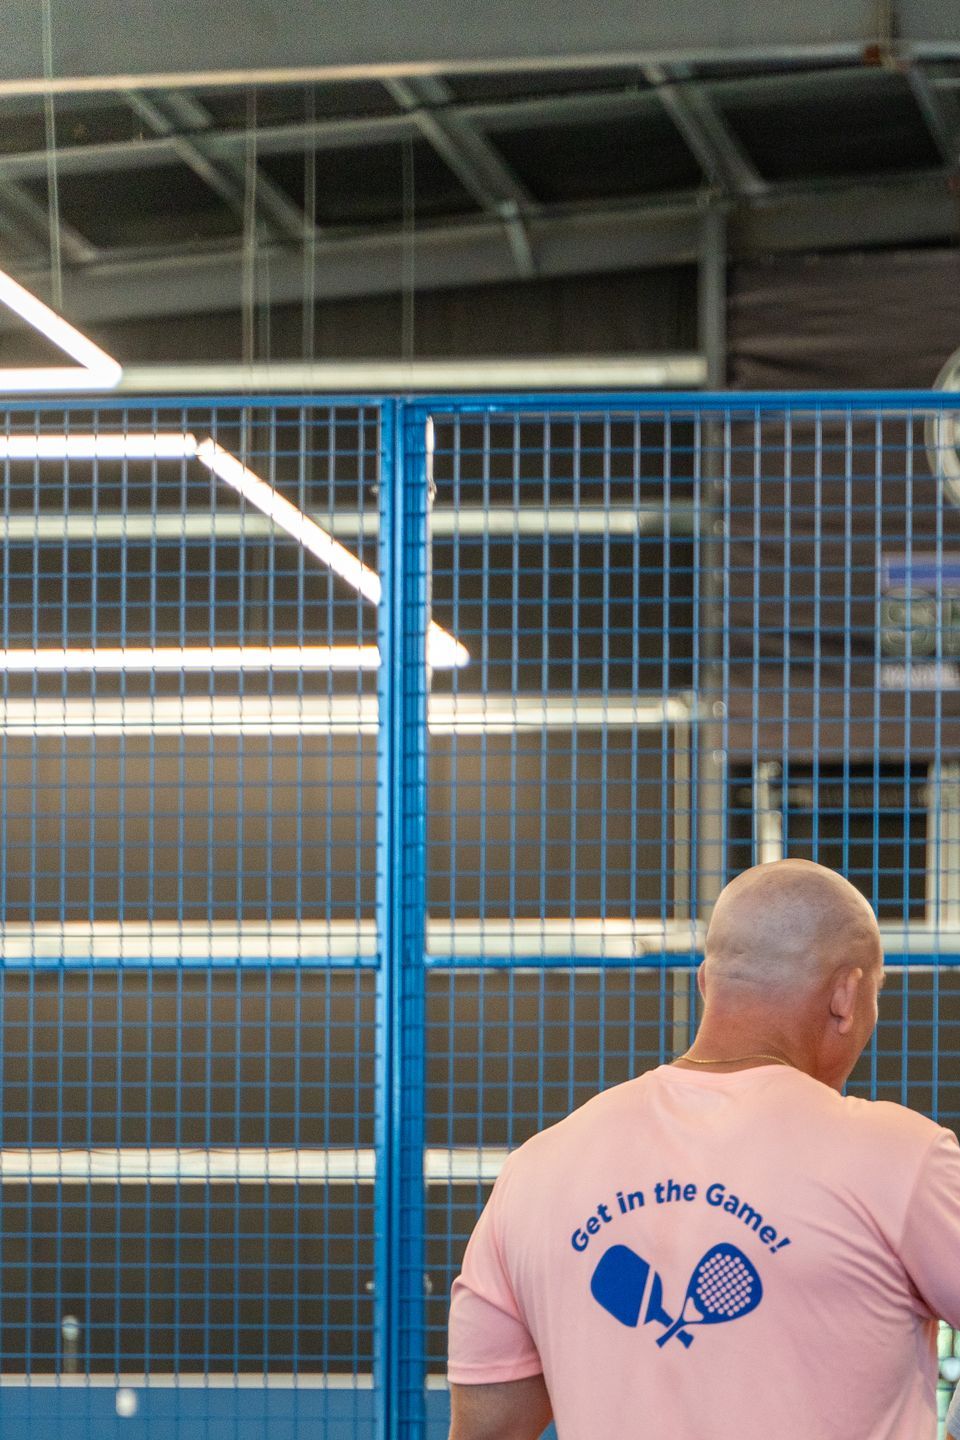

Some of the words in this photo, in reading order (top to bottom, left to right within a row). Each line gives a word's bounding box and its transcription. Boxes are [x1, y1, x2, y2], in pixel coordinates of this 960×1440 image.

[570, 1203, 613, 1252] Get
[616, 1191, 645, 1215] in
[654, 1179, 698, 1204] the
[705, 1183, 792, 1254] Game!
